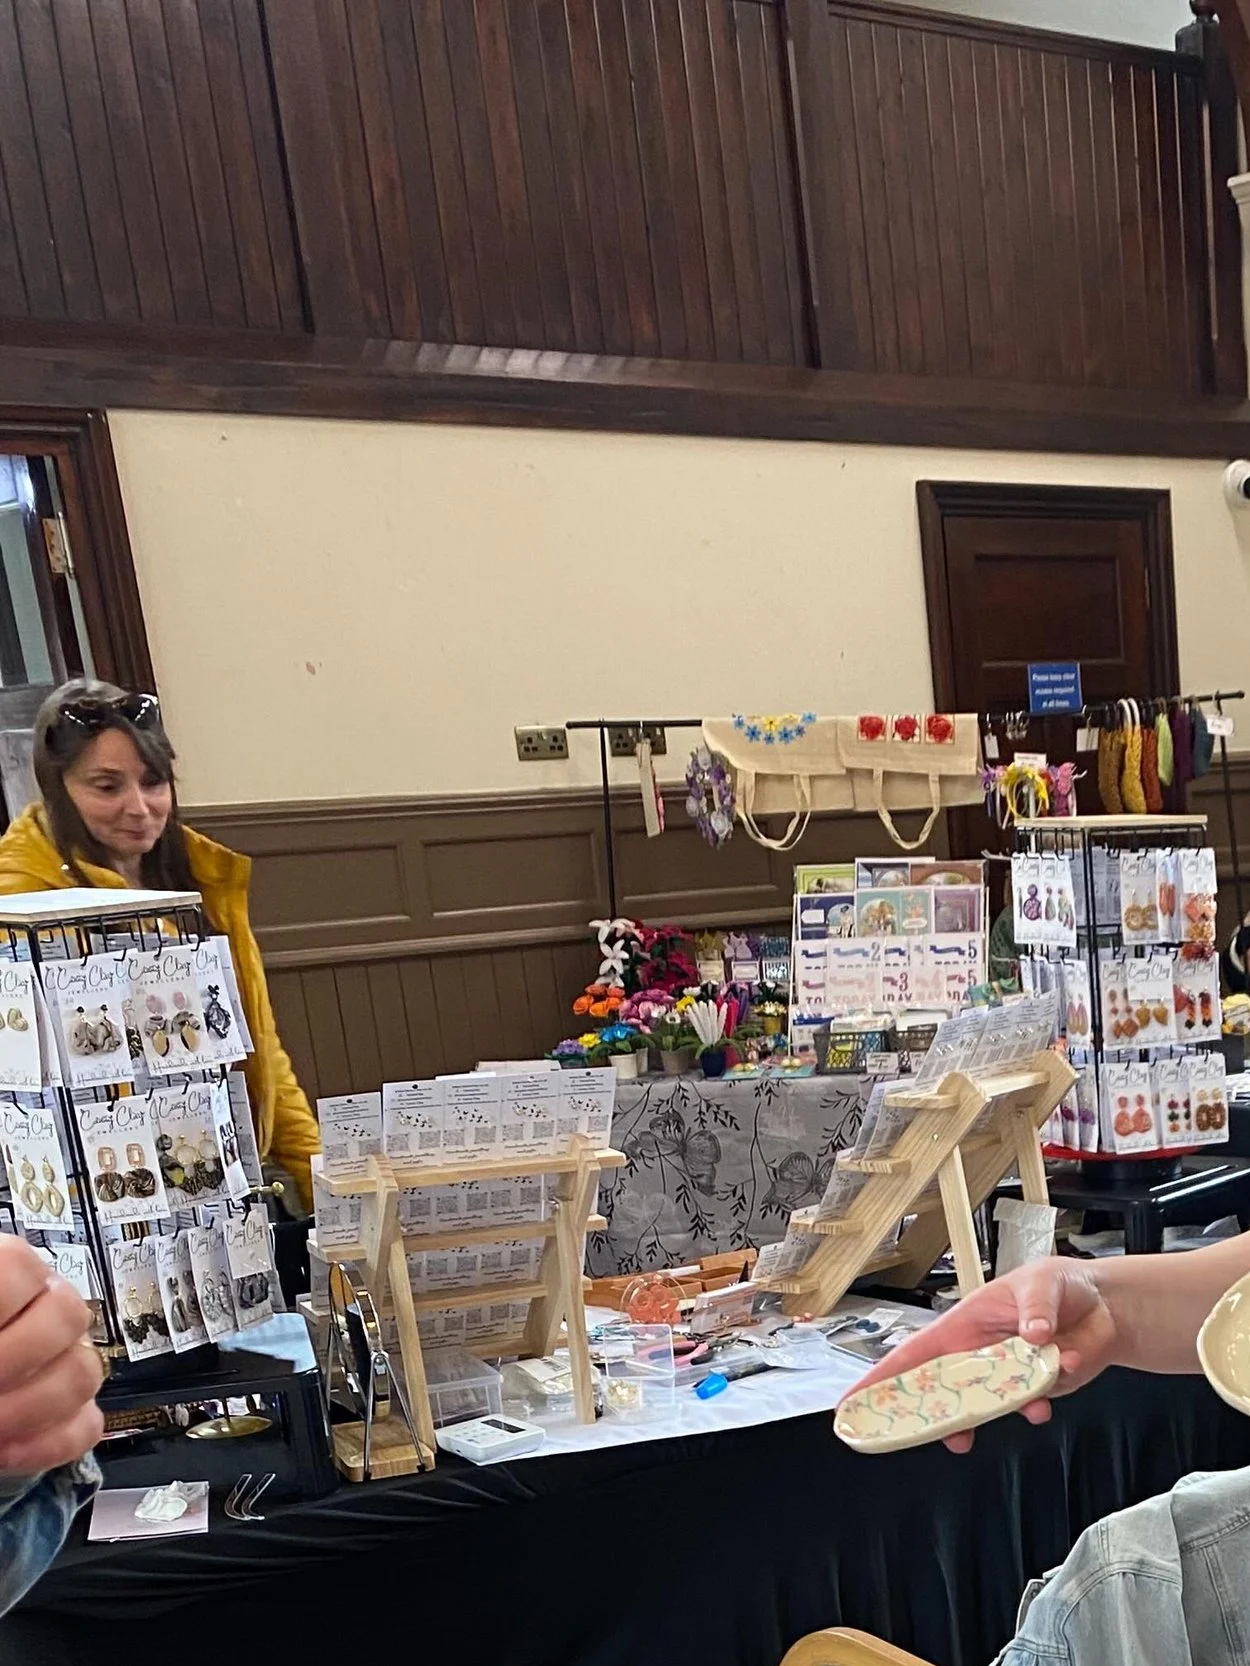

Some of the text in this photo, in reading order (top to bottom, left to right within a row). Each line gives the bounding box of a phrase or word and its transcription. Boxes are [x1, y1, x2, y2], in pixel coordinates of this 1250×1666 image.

[871, 942, 881, 962] 2
[968, 940, 977, 959] 5
[899, 972, 909, 992] 3
